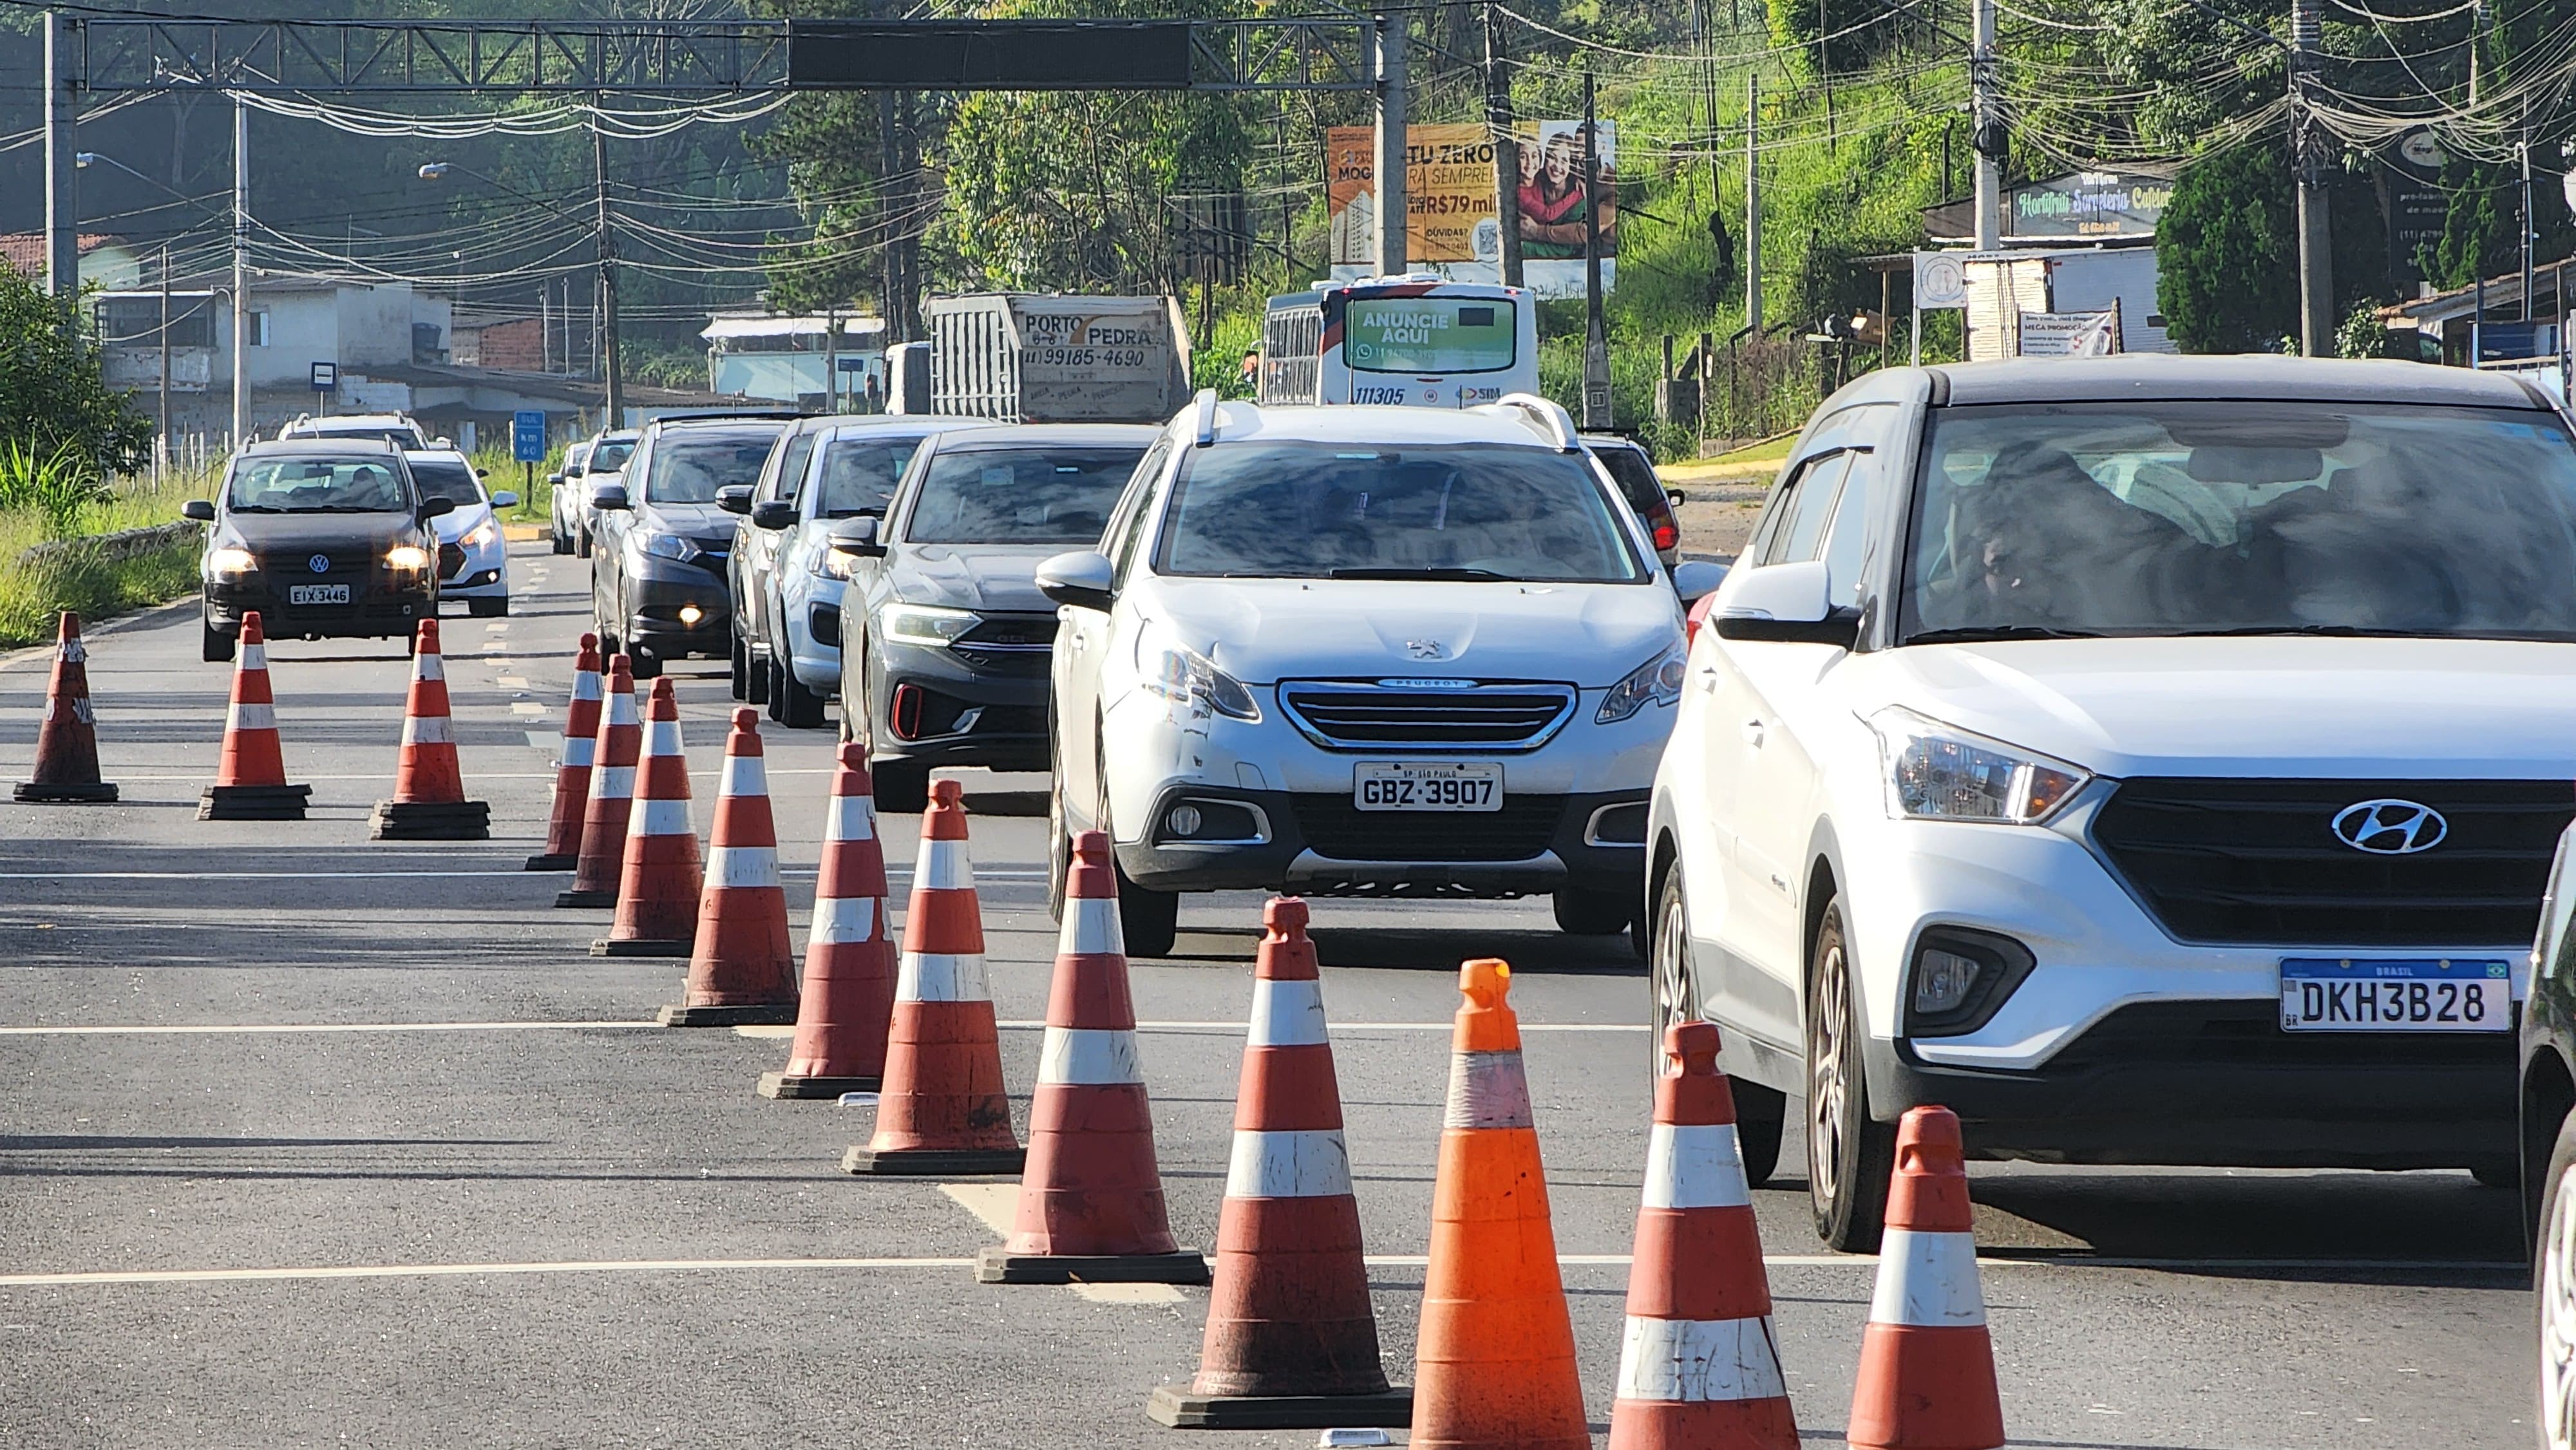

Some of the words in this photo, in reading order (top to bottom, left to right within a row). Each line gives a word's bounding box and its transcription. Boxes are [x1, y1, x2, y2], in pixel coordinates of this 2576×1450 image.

[1439, 142, 1494, 164] ZERO
[1426, 194, 1470, 216] R$79
[1472, 194, 1497, 213] mil
[1426, 225, 1468, 237] DÚVIDAS?
[1026, 315, 1083, 332] PORTO
[1363, 312, 1448, 329] ANUNCIE
[1089, 328, 1151, 344] PEDRA
[1381, 328, 1429, 344] AQUI
[1044, 349, 1144, 366] 99185-4690
[1356, 388, 1405, 405] 111305
[1479, 388, 1501, 399] SIM
[520, 433, 537, 442] km
[523, 446, 536, 455] 60
[1434, 770, 1457, 778] PAULO
[2376, 967, 2414, 976] BRASIL
[2301, 982, 2485, 1022] DKH3B28
[2286, 1014, 2298, 1026] BR
